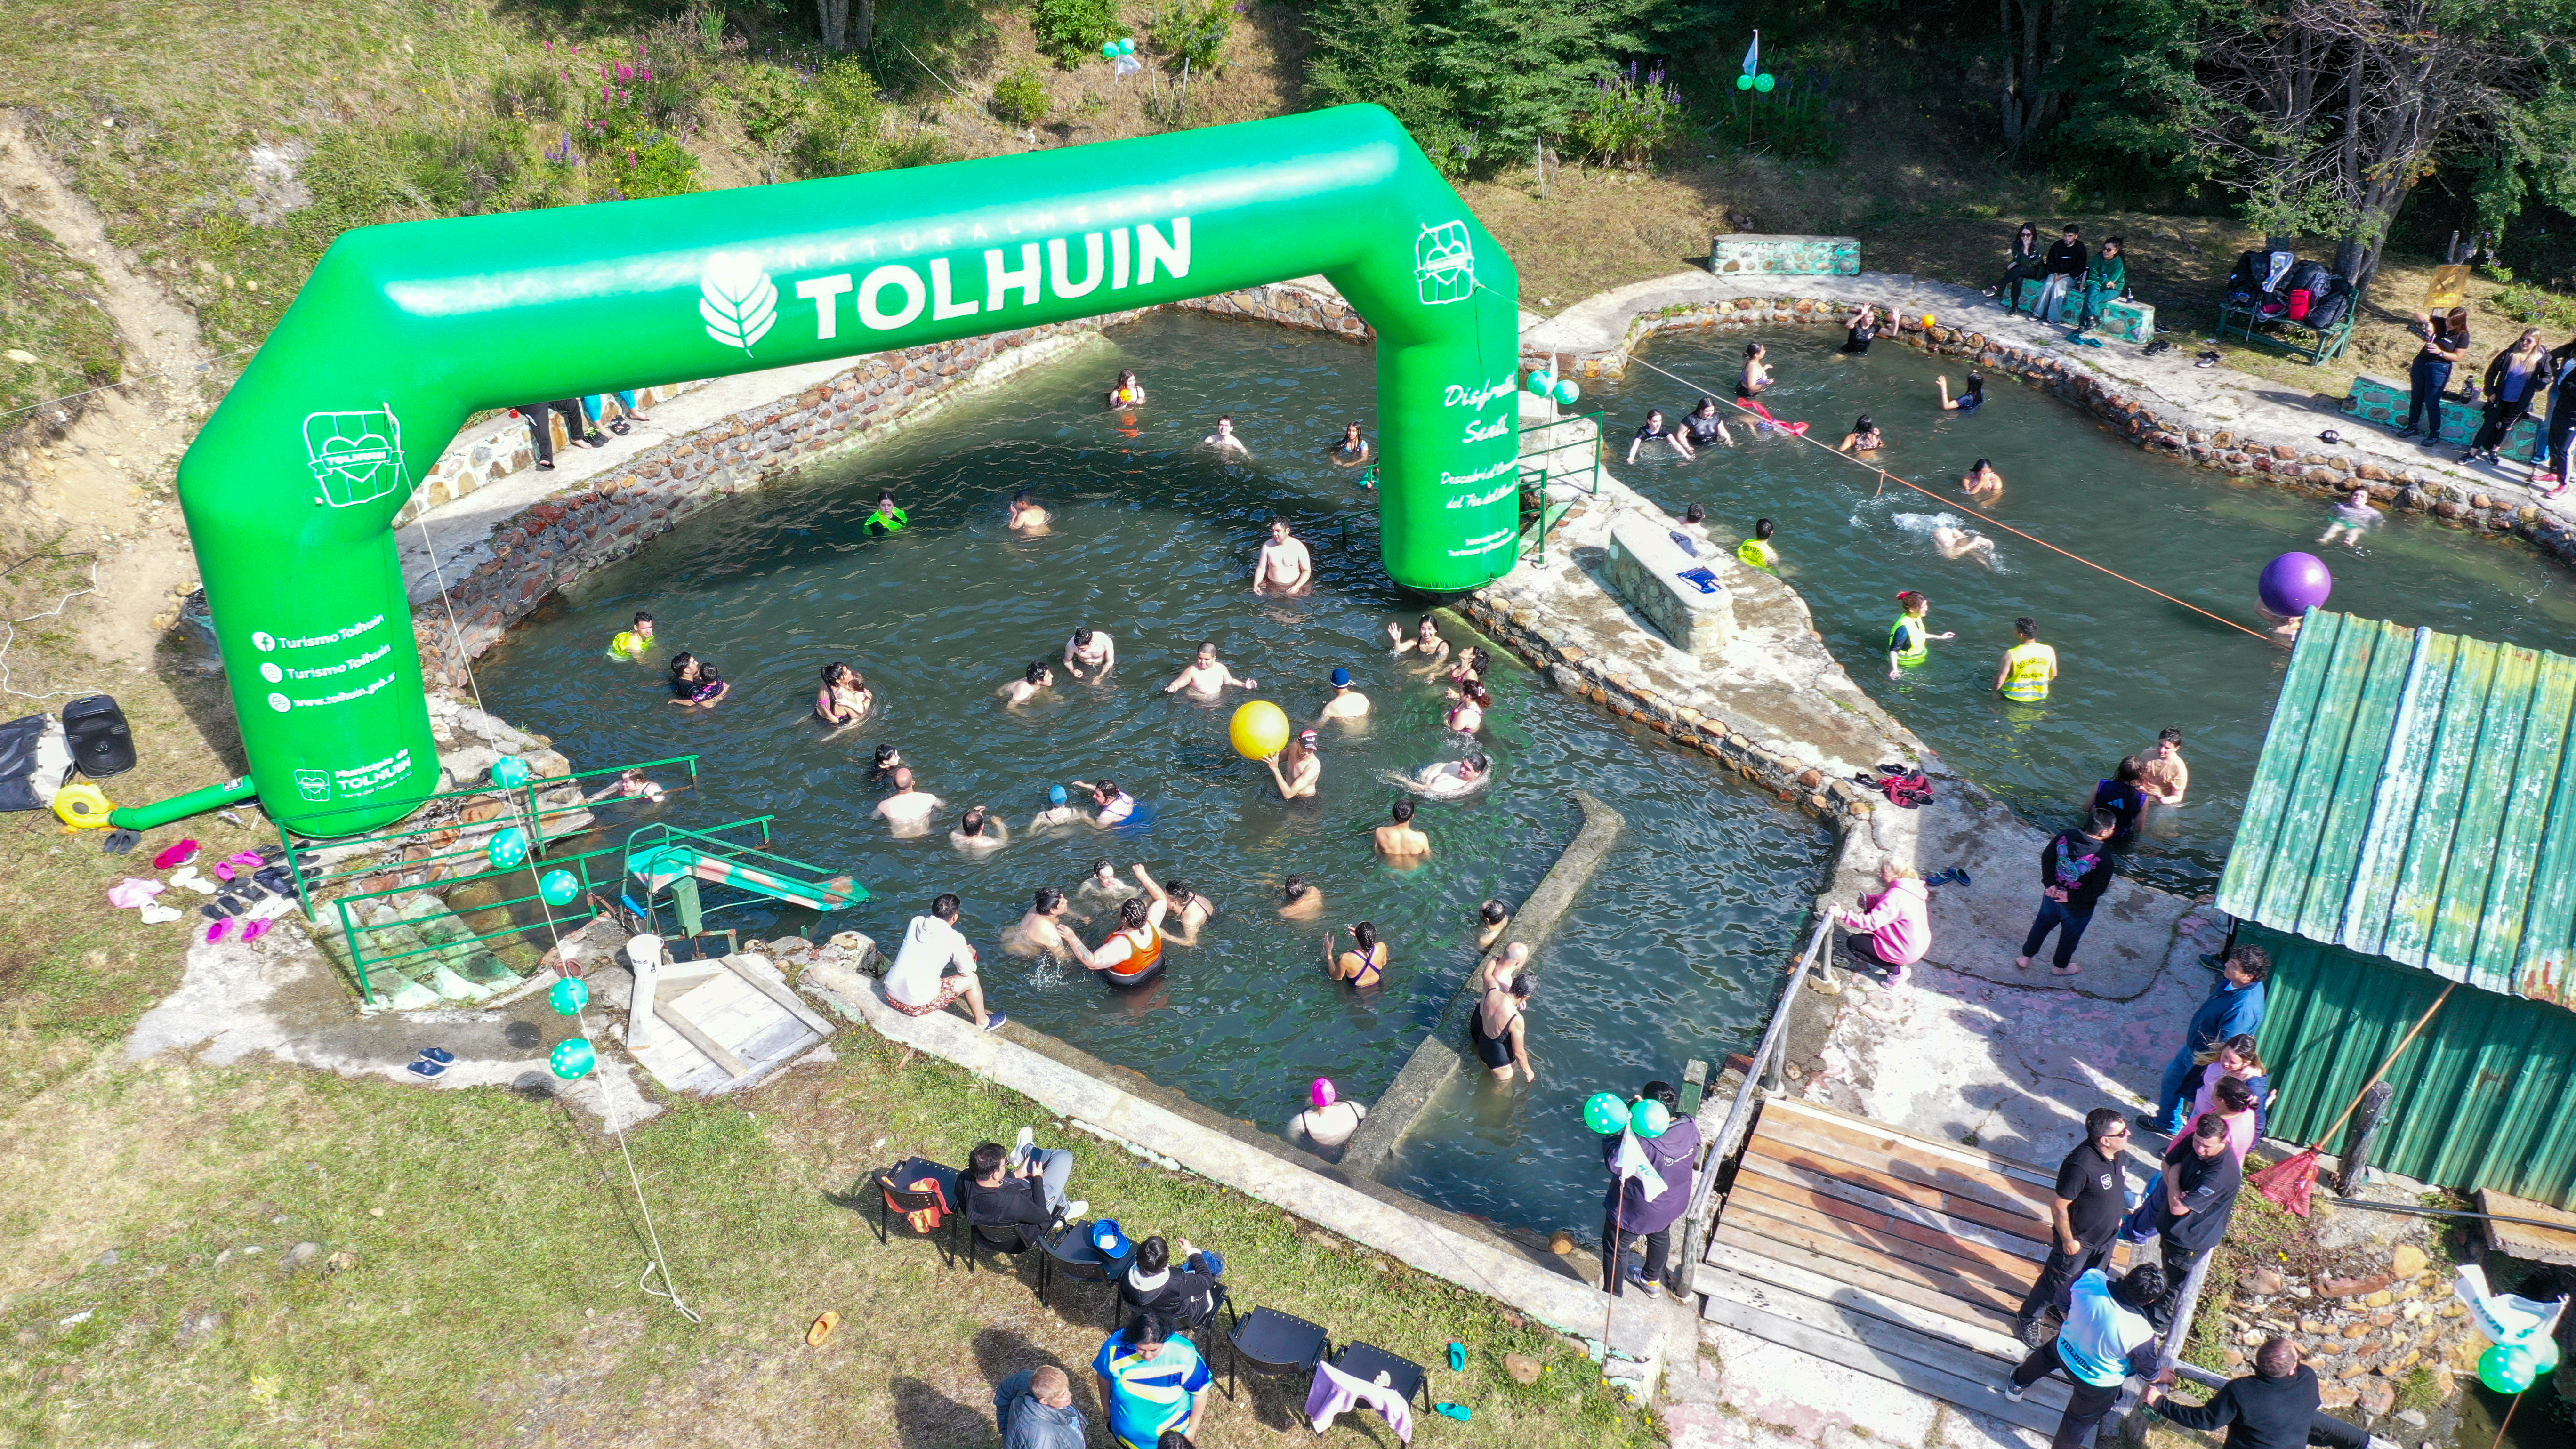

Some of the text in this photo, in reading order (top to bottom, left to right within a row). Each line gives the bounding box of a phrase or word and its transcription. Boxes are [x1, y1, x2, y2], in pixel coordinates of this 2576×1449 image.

[796, 217, 1191, 340] TOLHUIN
[324, 451, 386, 466] TOLHUIN
[336, 756, 411, 790] TOLHUIN
